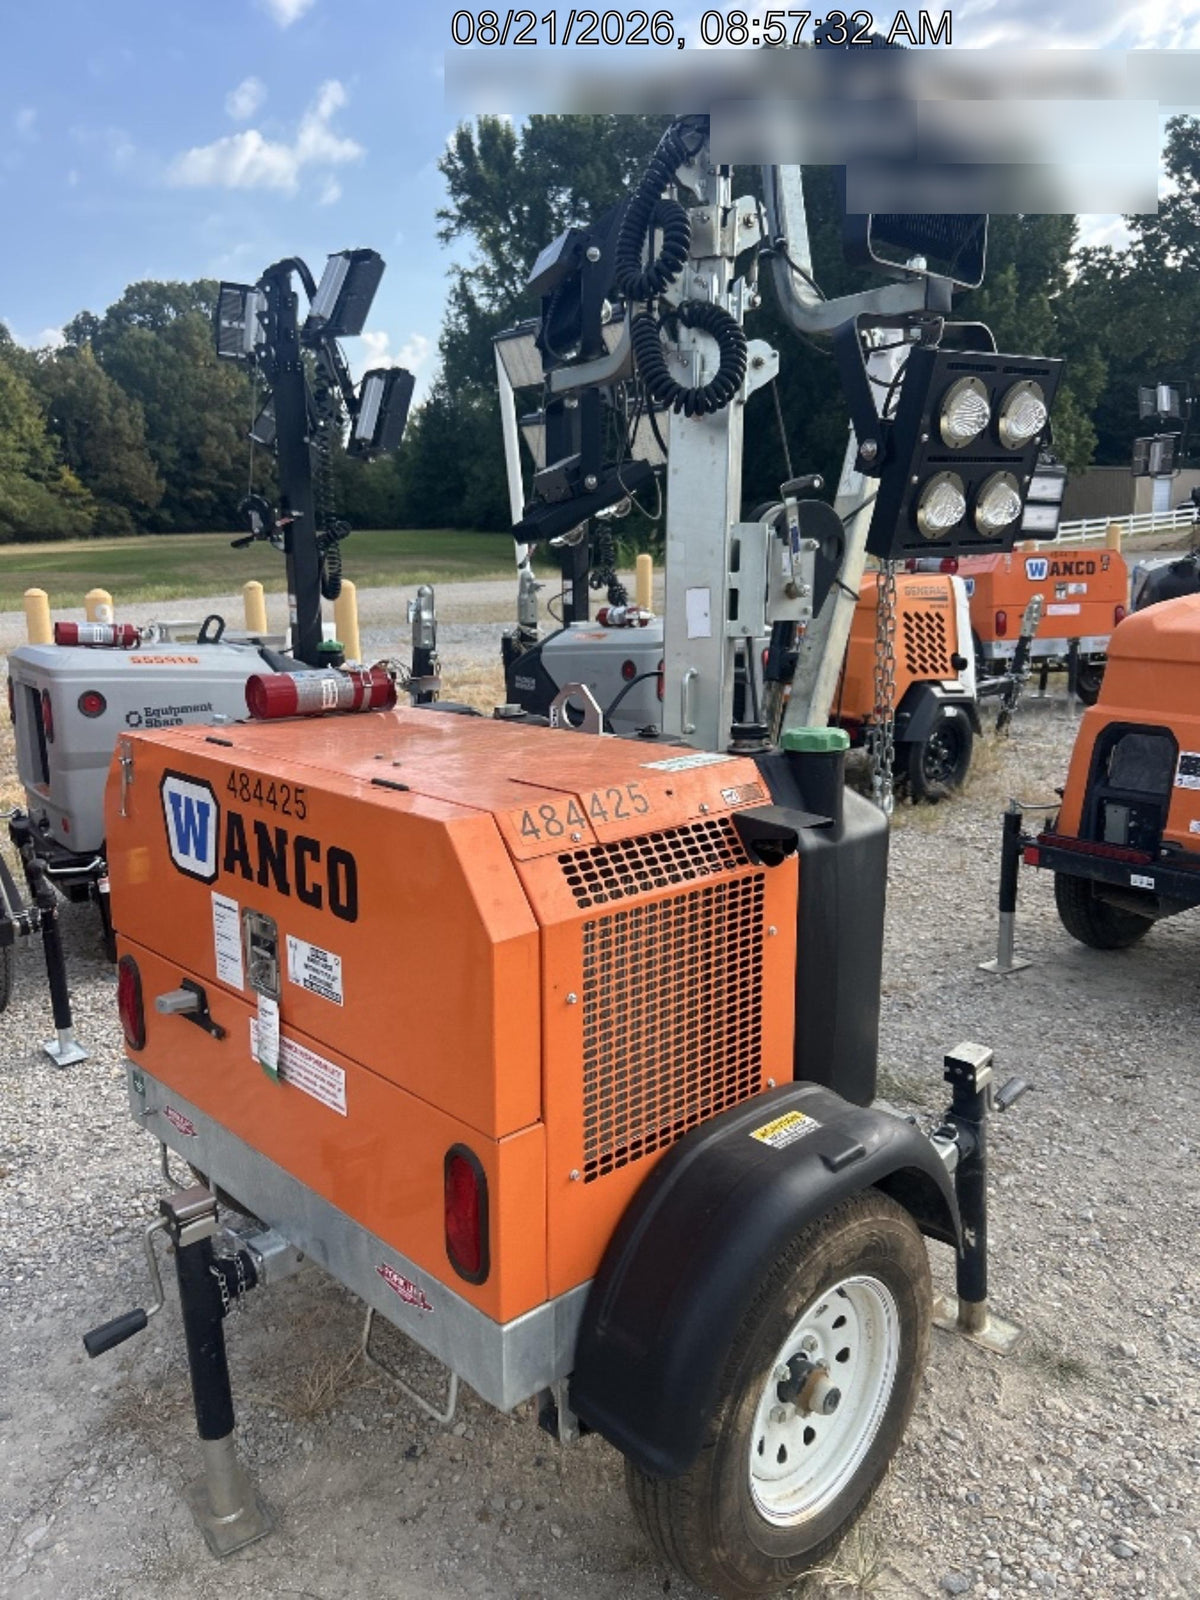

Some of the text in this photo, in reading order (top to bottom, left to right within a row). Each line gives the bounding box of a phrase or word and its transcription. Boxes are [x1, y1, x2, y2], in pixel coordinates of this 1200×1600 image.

[1028, 561, 1096, 577] WANCO
[143, 702, 214, 717] Equipment
[145, 717, 183, 728] Share
[227, 770, 307, 820] 484425
[521, 783, 649, 840] 484425
[167, 789, 359, 924] WANCO
